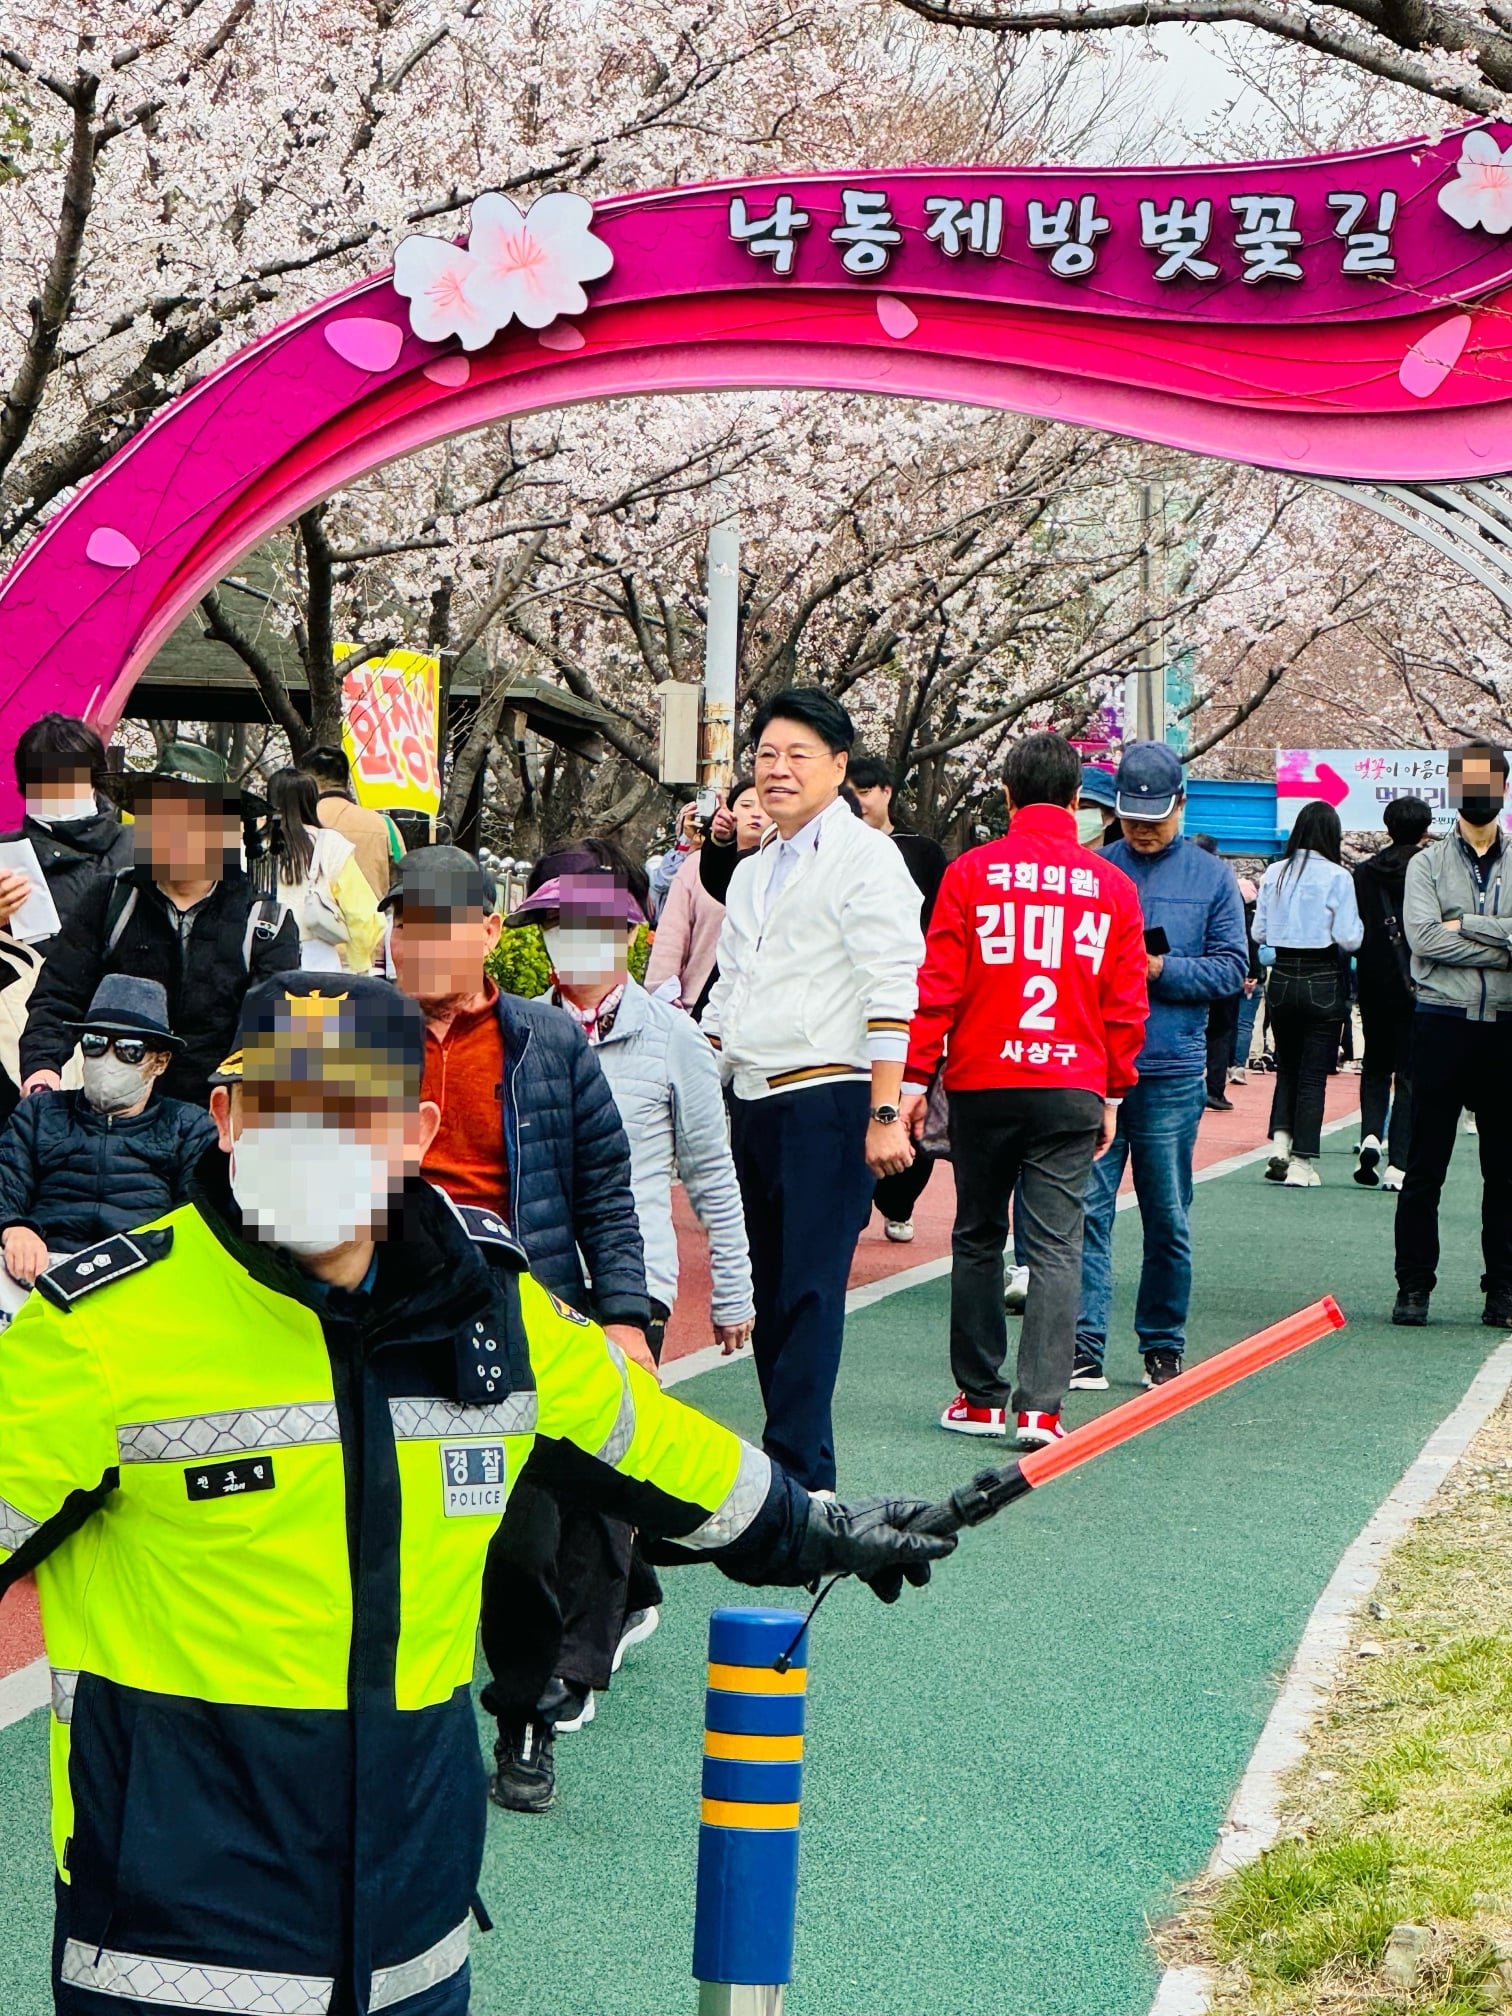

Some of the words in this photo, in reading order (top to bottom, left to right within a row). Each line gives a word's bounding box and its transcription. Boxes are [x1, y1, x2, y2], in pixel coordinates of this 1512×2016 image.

[1354, 757, 1399, 780] 벚꽃이
[975, 902, 1111, 976] 김대식
[1018, 975, 1058, 1031] 2
[1000, 1040, 1078, 1066] 사상구
[447, 1449, 502, 1484] 경찰
[450, 1490, 501, 1507] POLICE
